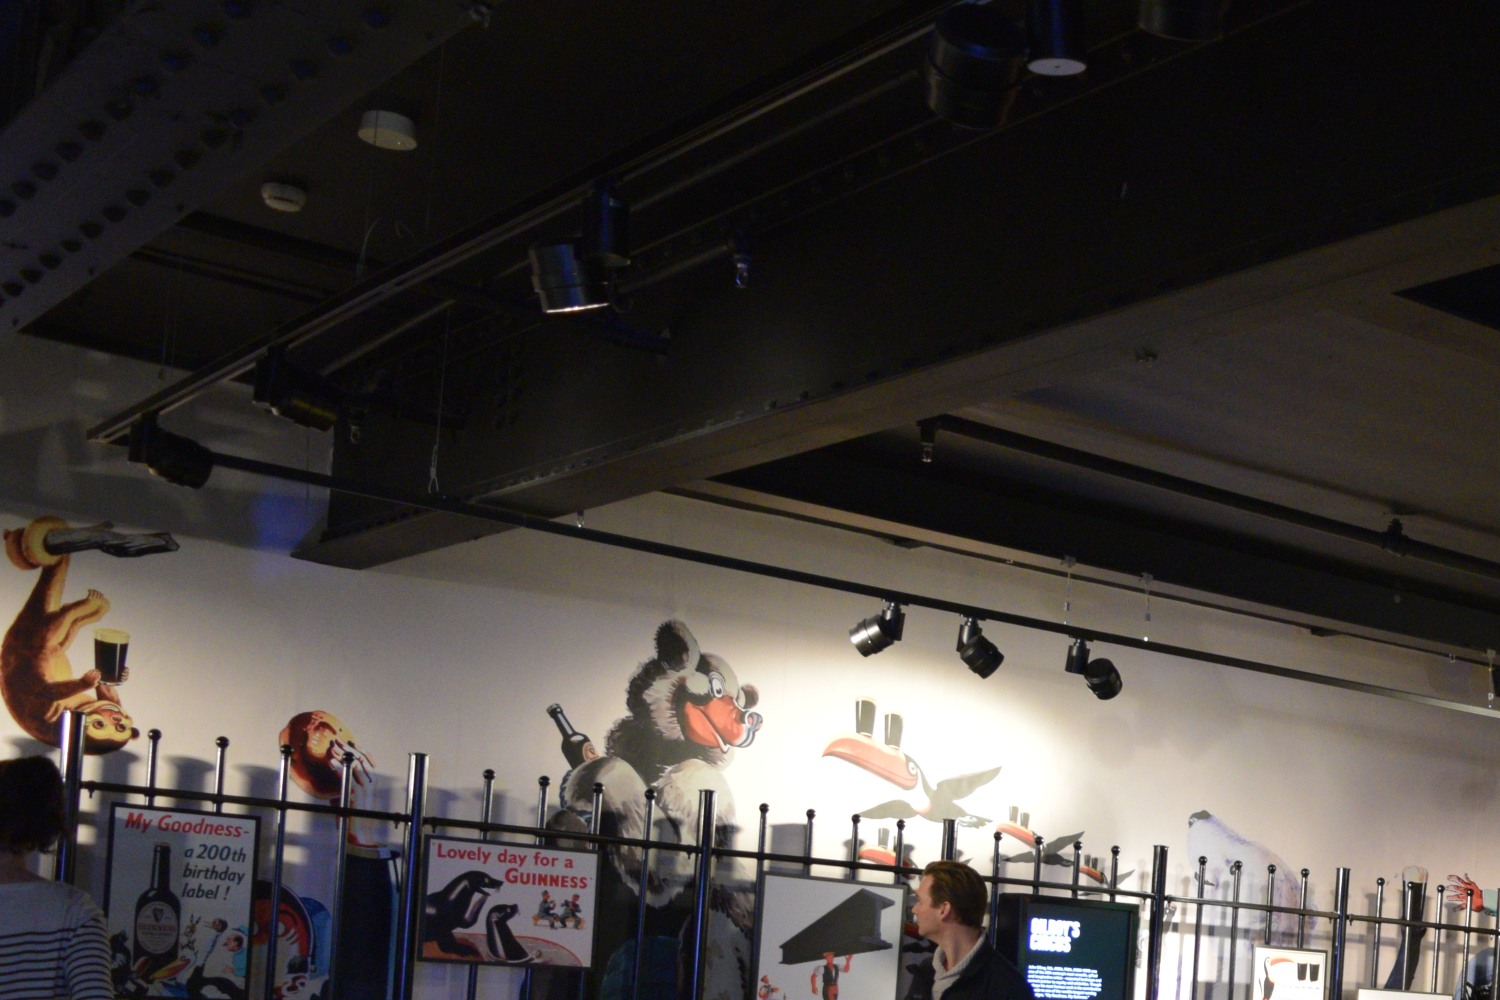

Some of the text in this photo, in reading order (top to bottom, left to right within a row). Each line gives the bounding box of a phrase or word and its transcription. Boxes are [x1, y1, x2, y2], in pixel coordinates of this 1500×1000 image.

[125, 812, 249, 838] My Goodness-
[184, 843, 247, 863] a 200th
[497, 849, 527, 867] day
[533, 851, 559, 867] for
[564, 858, 574, 869] a
[182, 862, 245, 885] birthday
[181, 883, 220, 899] label
